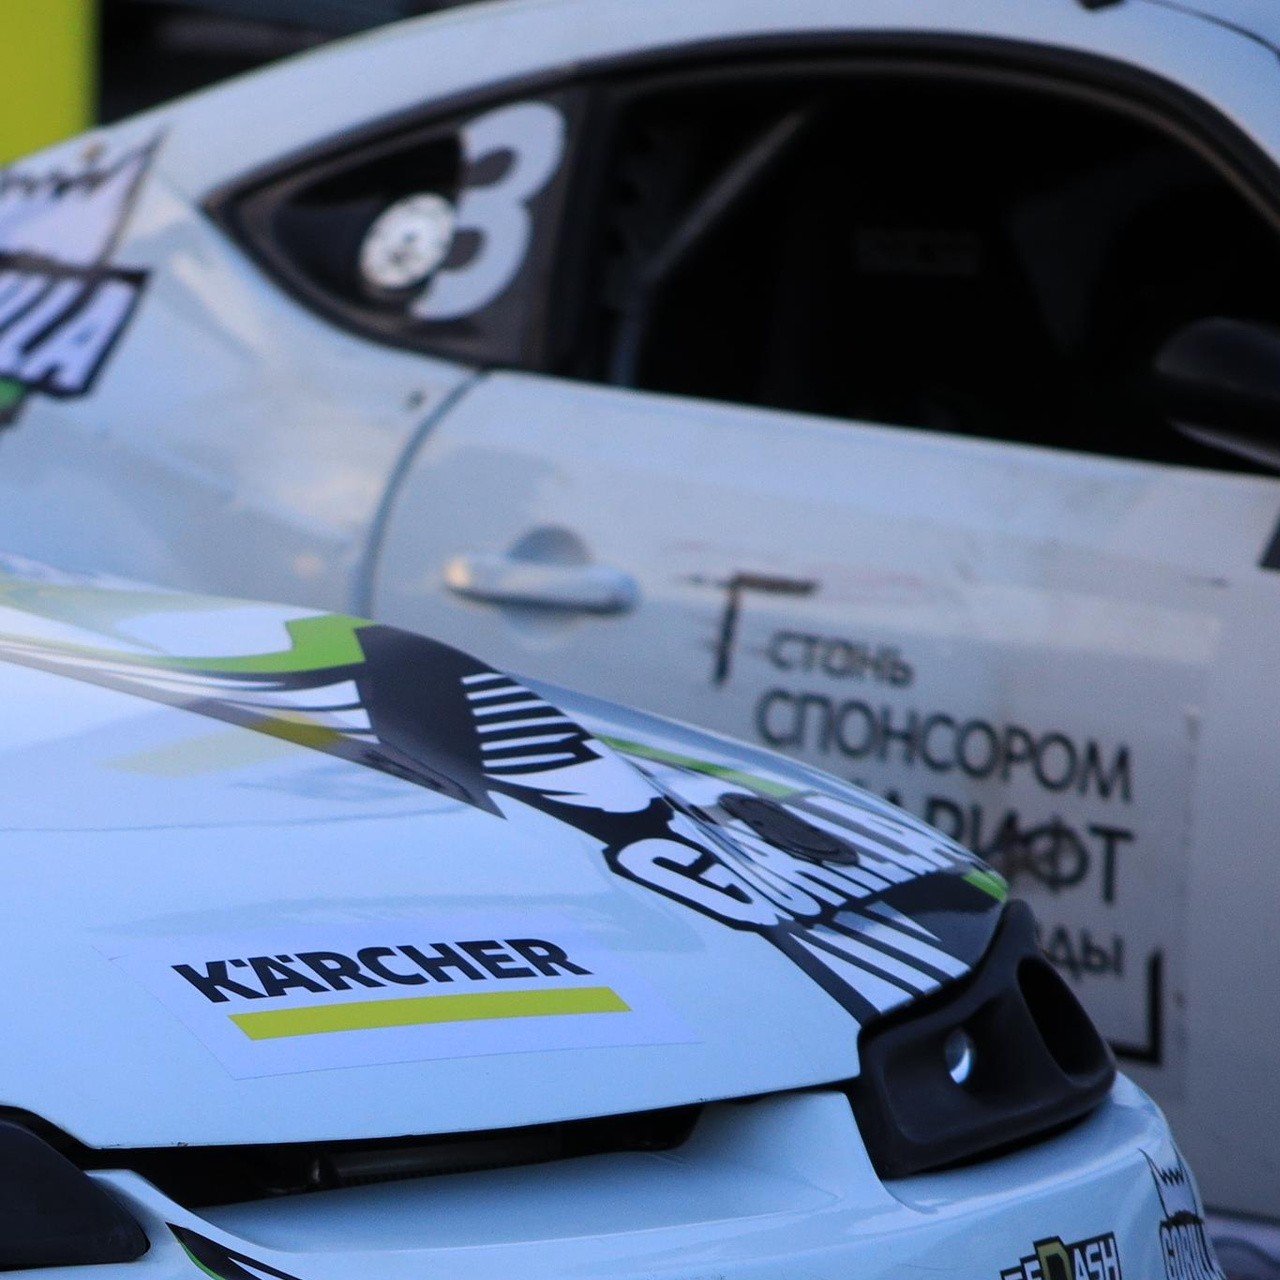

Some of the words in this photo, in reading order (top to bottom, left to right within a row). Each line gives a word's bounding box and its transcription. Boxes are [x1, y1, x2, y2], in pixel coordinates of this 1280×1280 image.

[408, 101, 568, 323] 3
[755, 688, 1132, 806] СПОНСОРОМ
[172, 938, 593, 1003] KÄRCHER
